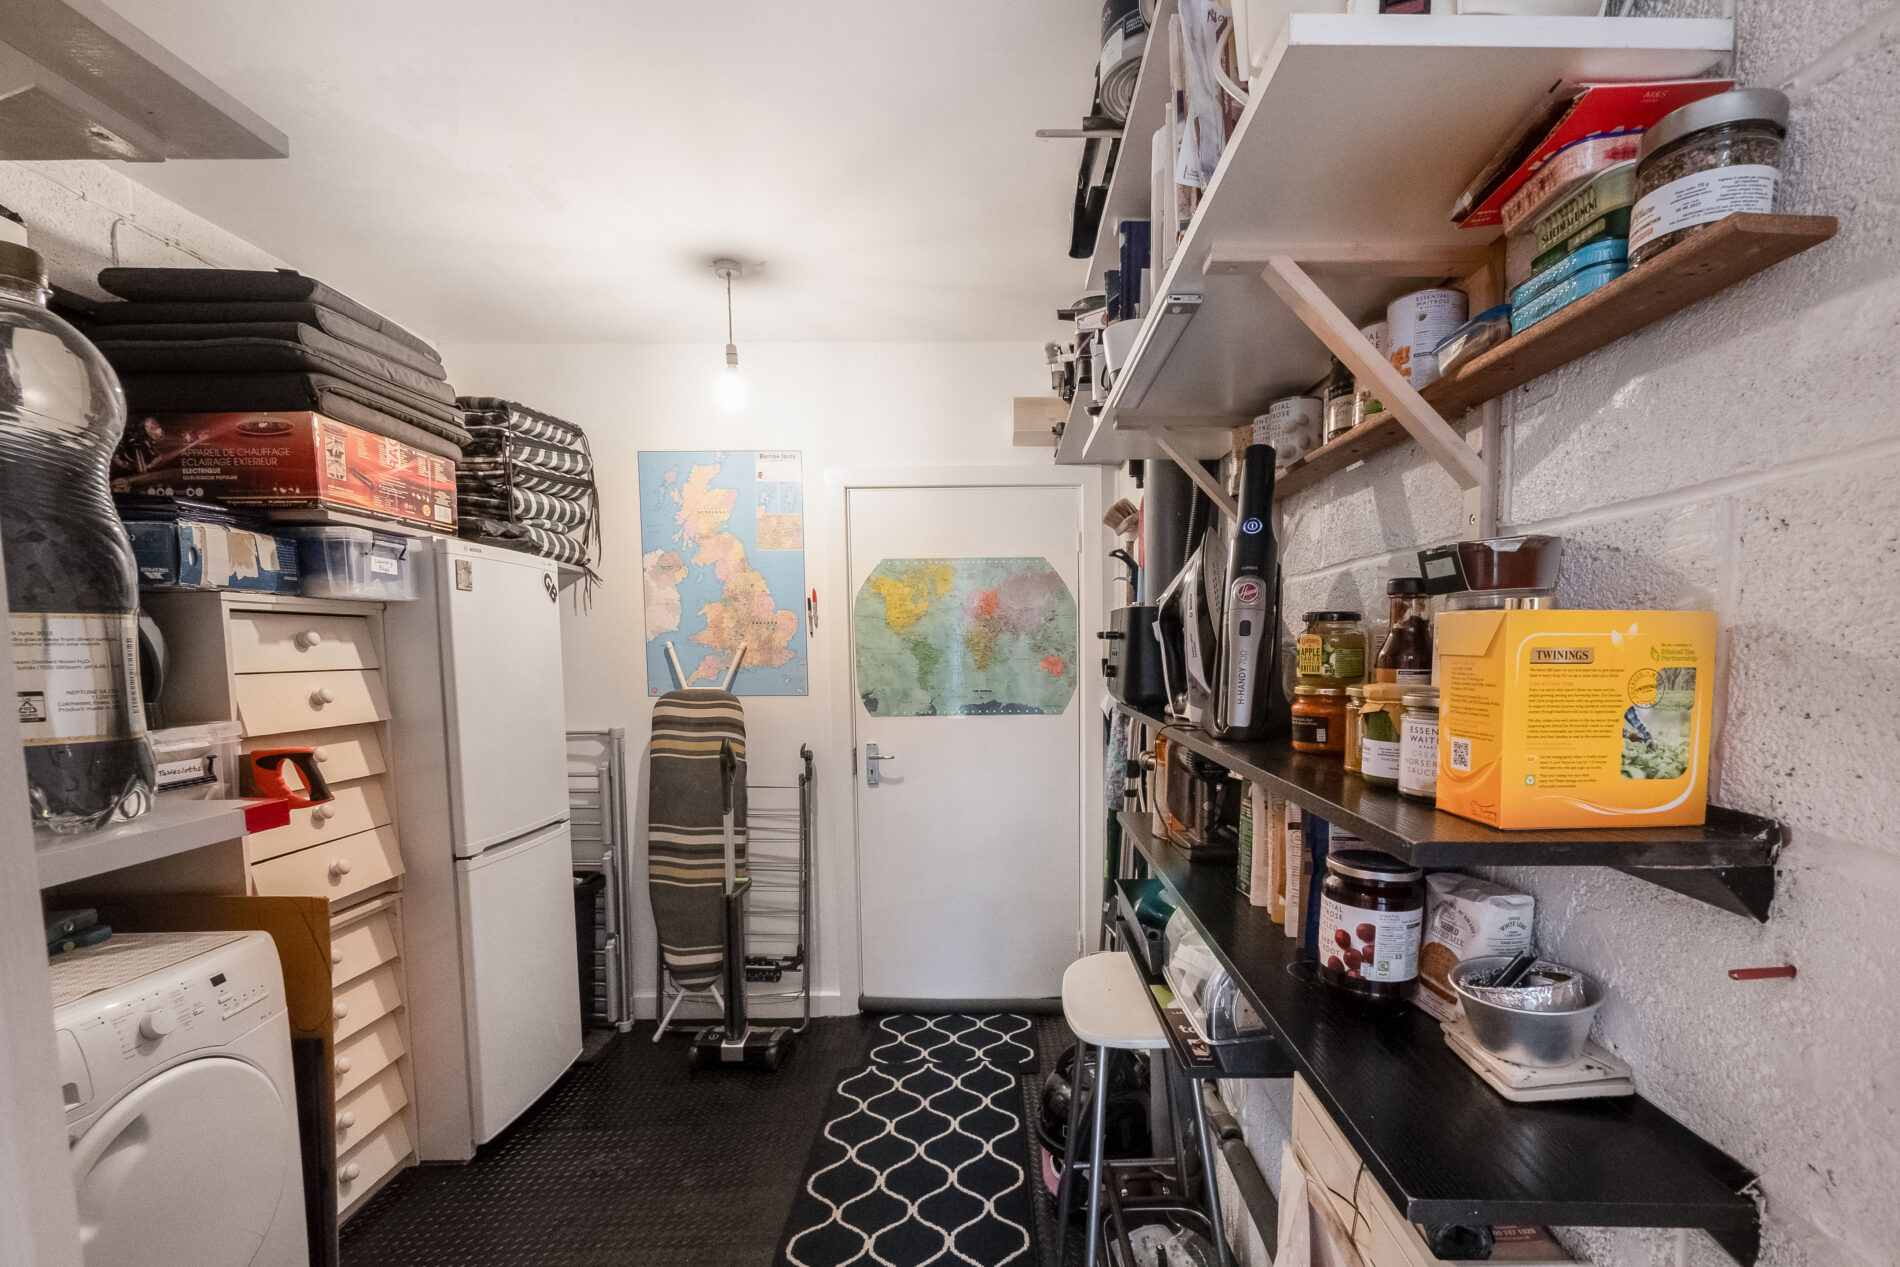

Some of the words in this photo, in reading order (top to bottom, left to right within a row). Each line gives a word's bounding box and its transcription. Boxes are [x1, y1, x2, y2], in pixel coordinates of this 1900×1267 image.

[1416, 293, 1449, 302] ESSENTIAL
[1416, 299, 1450, 307] WAITROSE
[223, 448, 235, 456] DE
[543, 573, 558, 603] GB
[1301, 648, 1320, 656] APPLE
[1536, 650, 1589, 660] TWININGS
[1237, 668, 1247, 705] H-HANDY
[1408, 767, 1436, 776] SAUCE
[1449, 935, 1465, 947] MIX
